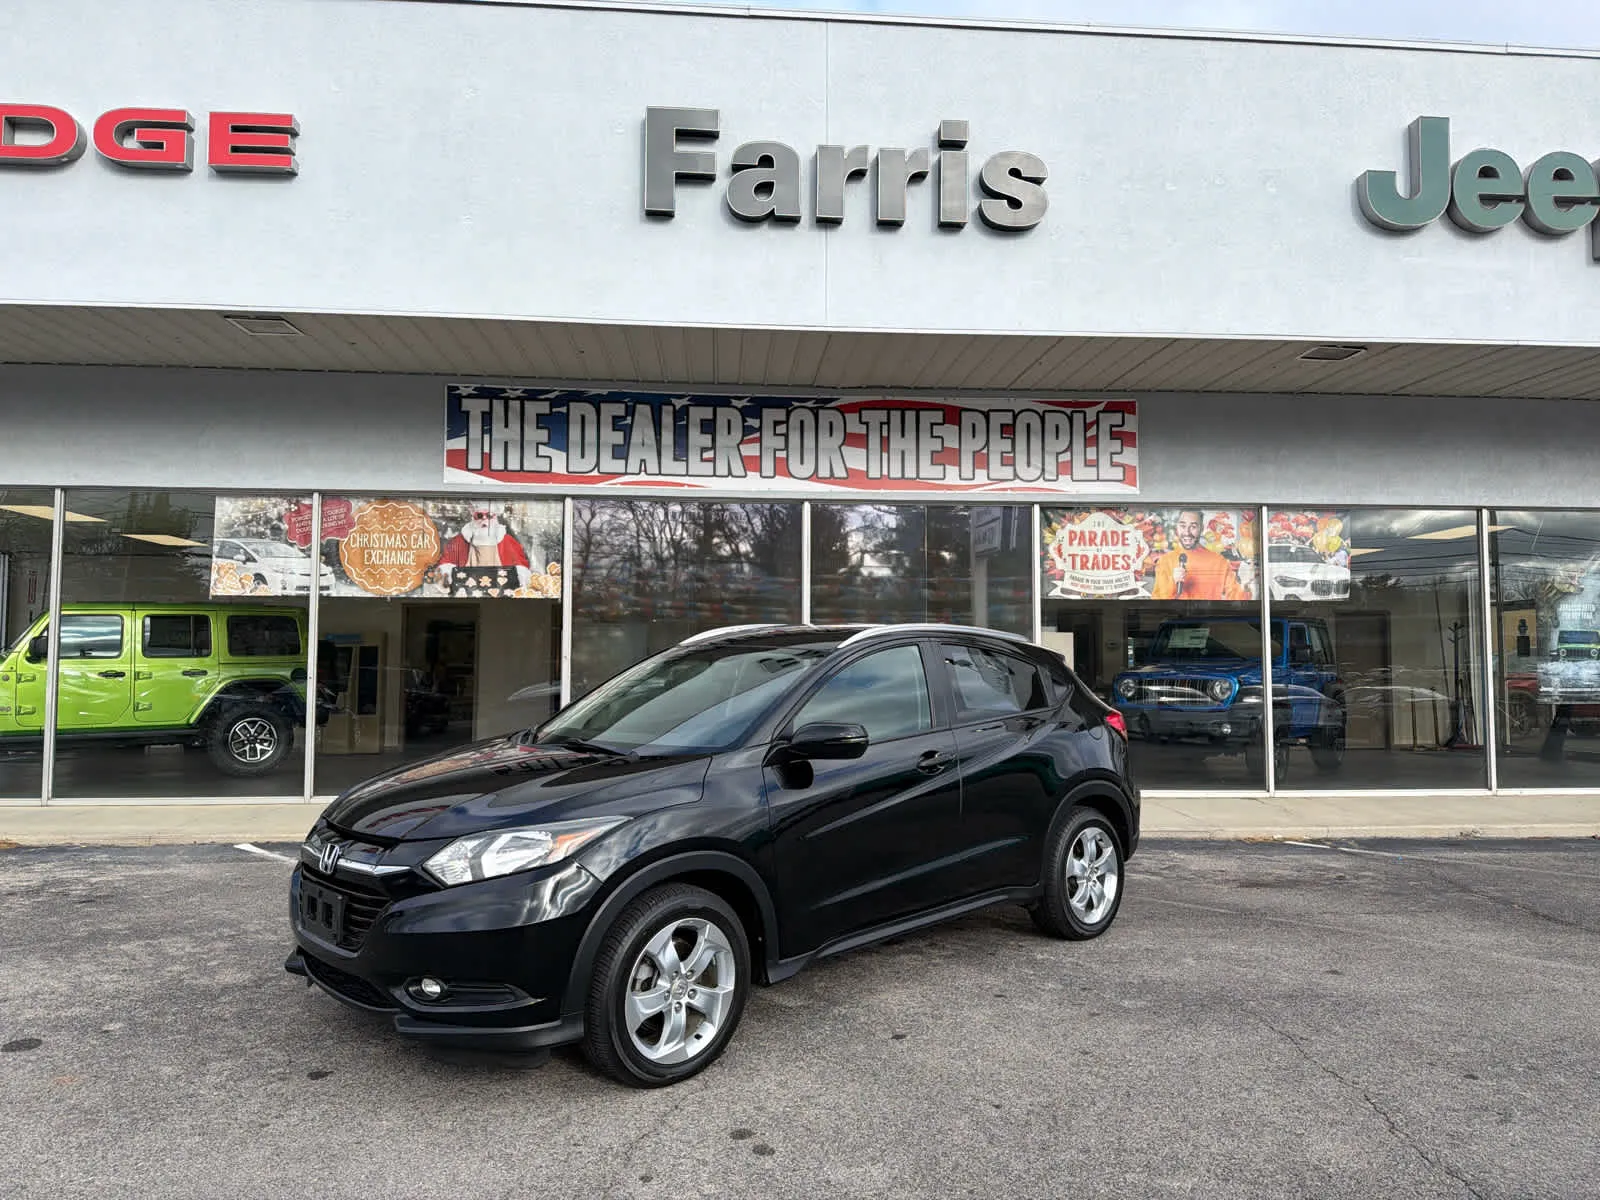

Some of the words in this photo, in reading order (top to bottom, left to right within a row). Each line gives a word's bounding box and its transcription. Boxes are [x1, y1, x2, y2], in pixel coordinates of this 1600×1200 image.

[645, 106, 1049, 231] Farris
[1357, 115, 1600, 262] Jee
[460, 398, 552, 472] THE
[566, 400, 748, 478] DEALER
[759, 406, 848, 480] FOR
[859, 406, 946, 481] THE
[958, 407, 1125, 483] PEOPLE
[350, 532, 408, 548] CHRISTMAS
[410, 533, 431, 549] CAR
[1068, 530, 1130, 546] PARADE
[364, 550, 416, 565] EXCHANGE
[1068, 554, 1131, 570] TRADES
